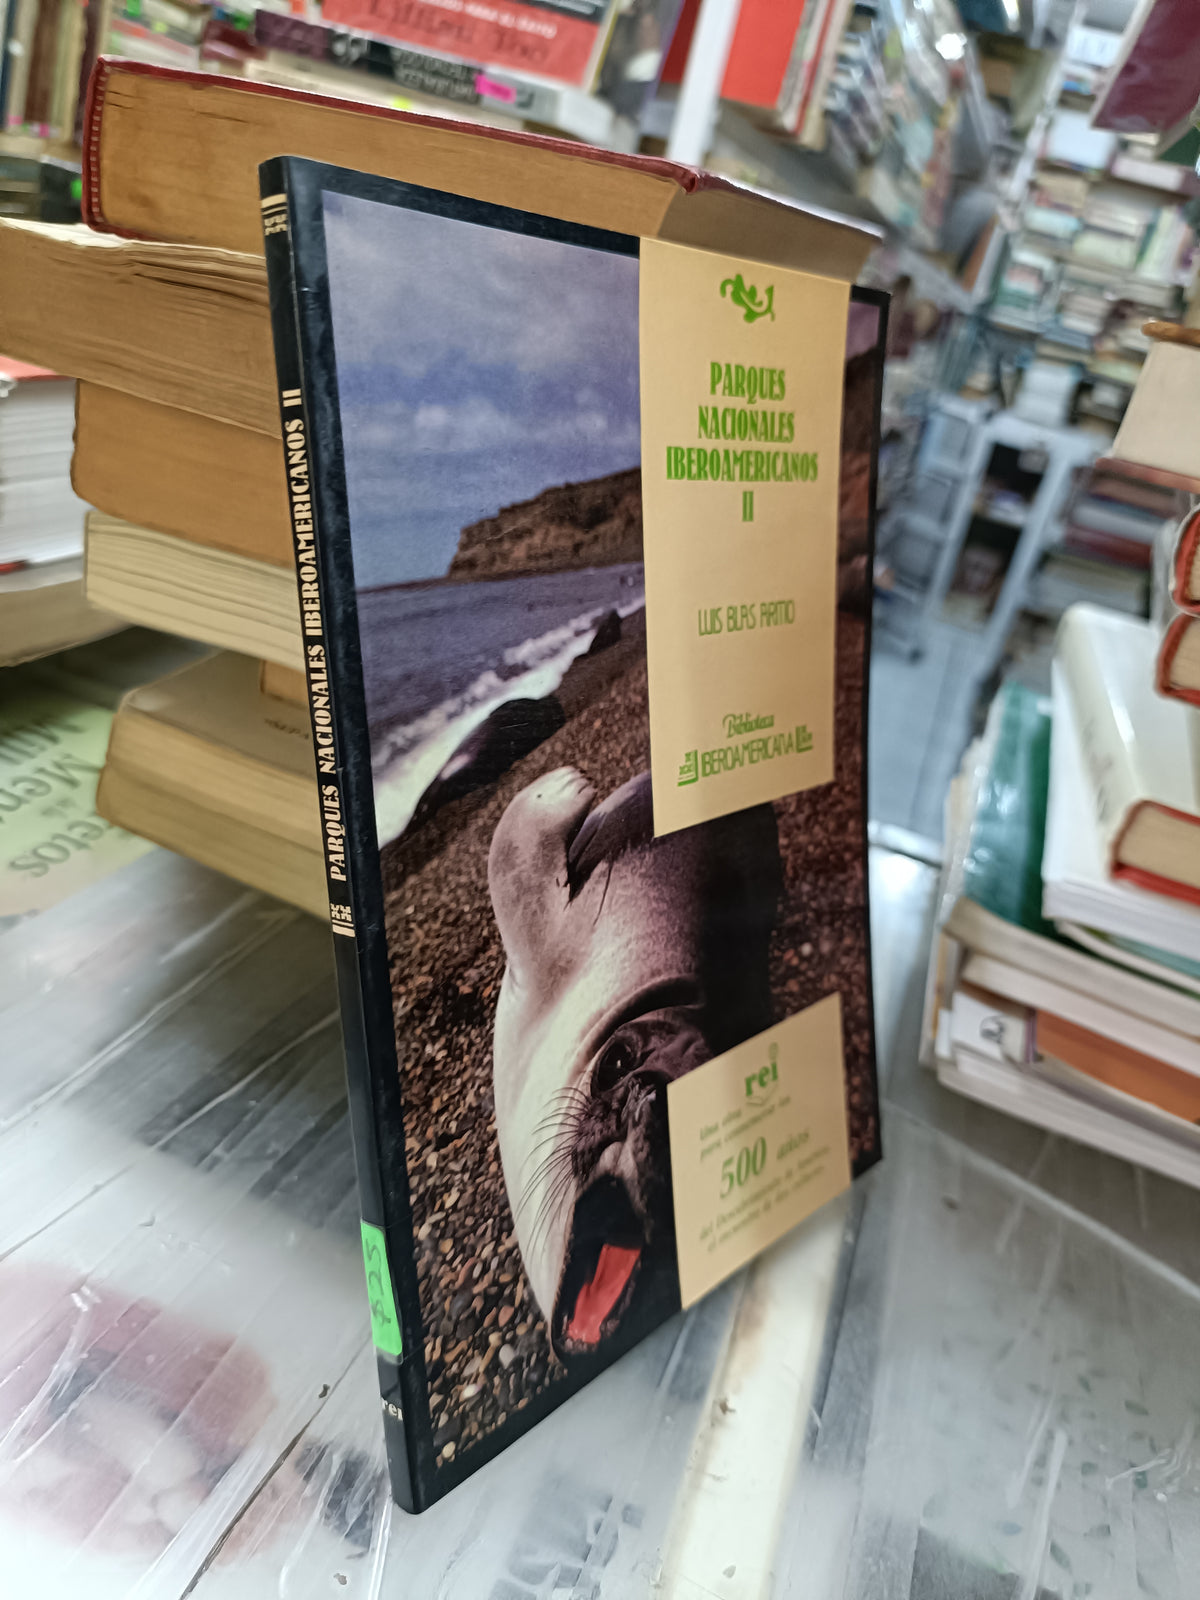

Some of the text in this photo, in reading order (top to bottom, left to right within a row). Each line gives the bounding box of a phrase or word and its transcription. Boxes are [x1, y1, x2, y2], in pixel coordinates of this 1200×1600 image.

[710, 361, 786, 404] PARQUES
[698, 405, 795, 443] NACIONALES
[666, 446, 818, 482] IBEROAMERICANOS
[742, 491, 754, 522] II
[282, 388, 347, 881] PARQUES NACIONALES IBEROAMERICANOS II
[698, 607, 723, 637] LUIS
[727, 603, 756, 633] BLAS
[701, 731, 793, 778] IBEROAMERICANA
[744, 1042, 779, 1097] rei
[720, 1136, 767, 1199] 500
